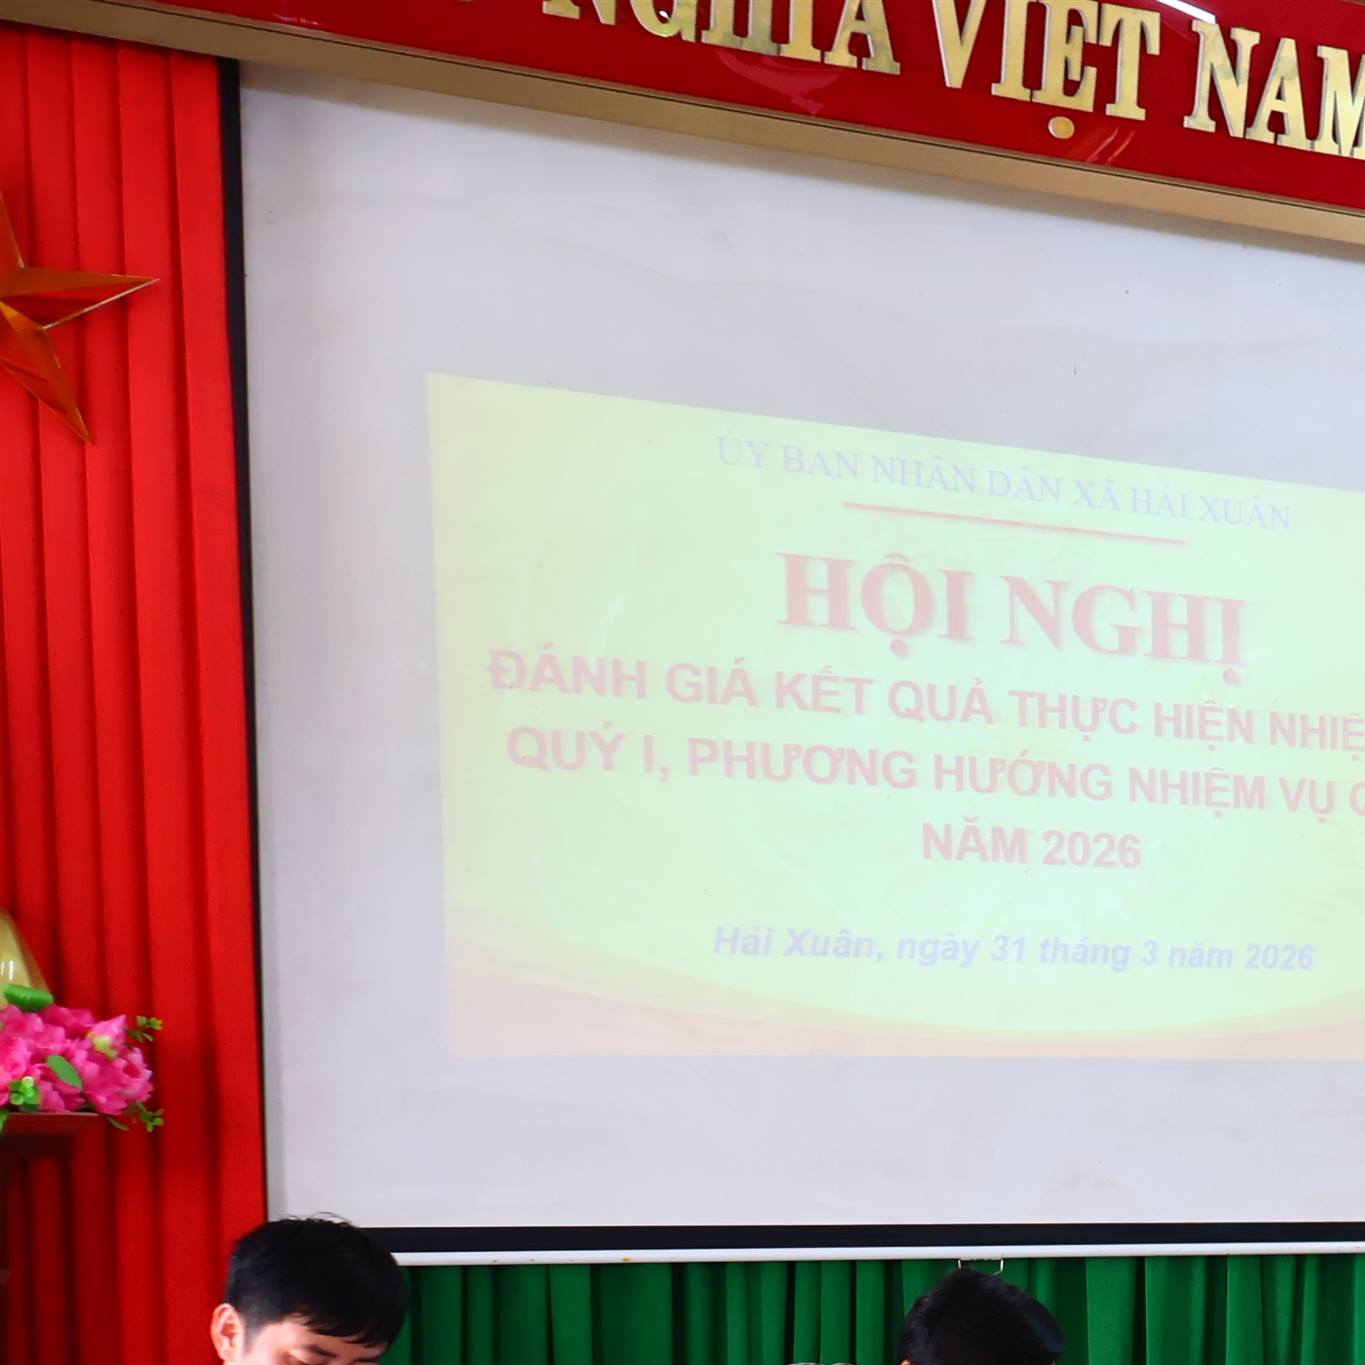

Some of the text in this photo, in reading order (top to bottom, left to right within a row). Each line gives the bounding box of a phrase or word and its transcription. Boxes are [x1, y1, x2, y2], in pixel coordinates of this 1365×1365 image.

[782, 444, 859, 480] BAN
[872, 454, 977, 495] NHÂN
[986, 467, 1061, 503] DÂN
[1072, 477, 1120, 512] XÃ
[1198, 495, 1292, 530] XUÂN
[776, 552, 1247, 685] HỘI NGHỊ
[487, 641, 648, 700] ĐÁNH
[664, 656, 759, 709] GIÁ
[774, 666, 875, 717] KẾT
[888, 678, 995, 725] QUẢ
[1008, 689, 1139, 741] THỰC
[1153, 699, 1256, 751] HIỆN
[506, 721, 626, 773] QUÝ
[642, 734, 671, 783] I,
[687, 736, 917, 791] PHƯƠNG
[934, 749, 1114, 802] HƯỚNG
[1127, 765, 1268, 818] NHIỆM
[1278, 776, 1336, 823] VỤ
[922, 815, 1143, 869] NĂM 2026
[713, 926, 1315, 972] Hải Xuân, ngày 31 tháng 3 năm 2026
